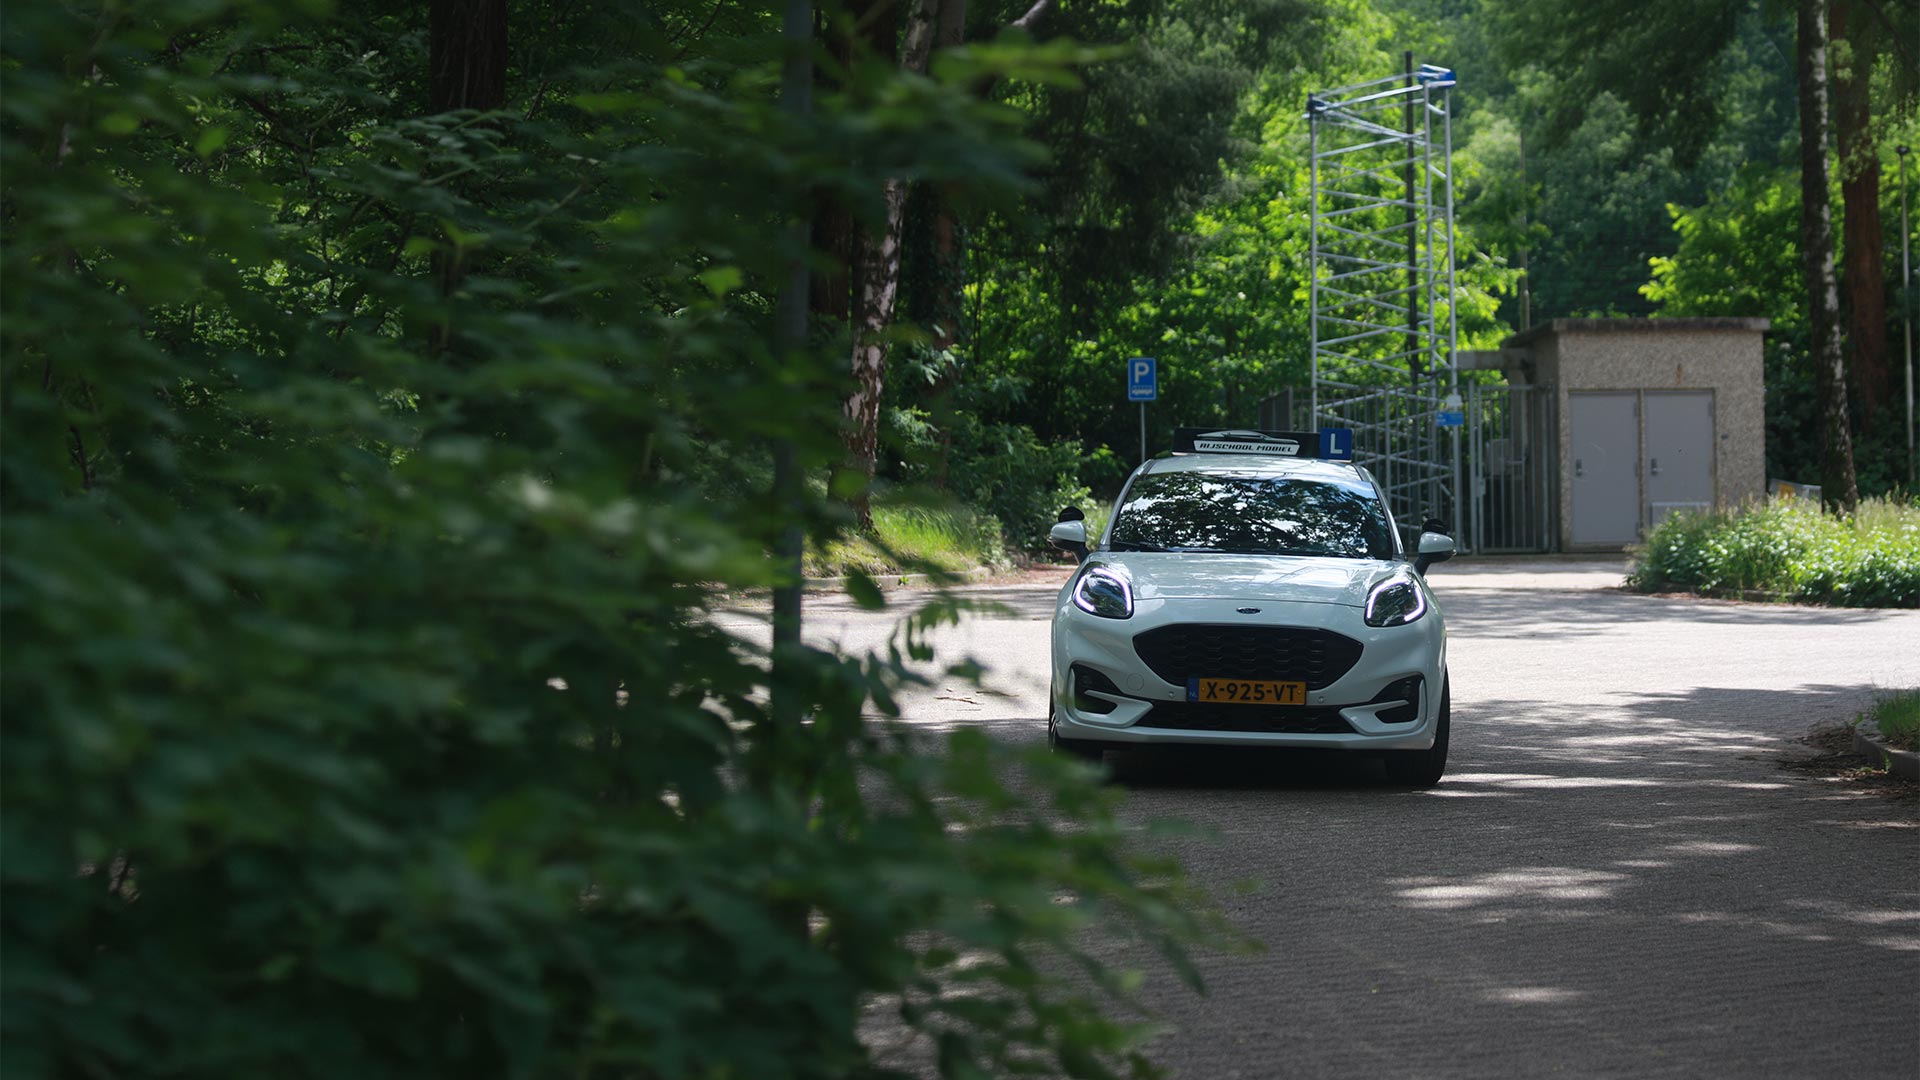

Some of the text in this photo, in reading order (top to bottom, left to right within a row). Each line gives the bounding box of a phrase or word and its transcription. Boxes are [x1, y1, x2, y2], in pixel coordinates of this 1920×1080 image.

[1135, 362, 1149, 384] P
[1200, 443, 1293, 453] RIJSCHOOL MOBIEL
[1330, 433, 1343, 454] L
[1206, 682, 1298, 701] X-925-VT
